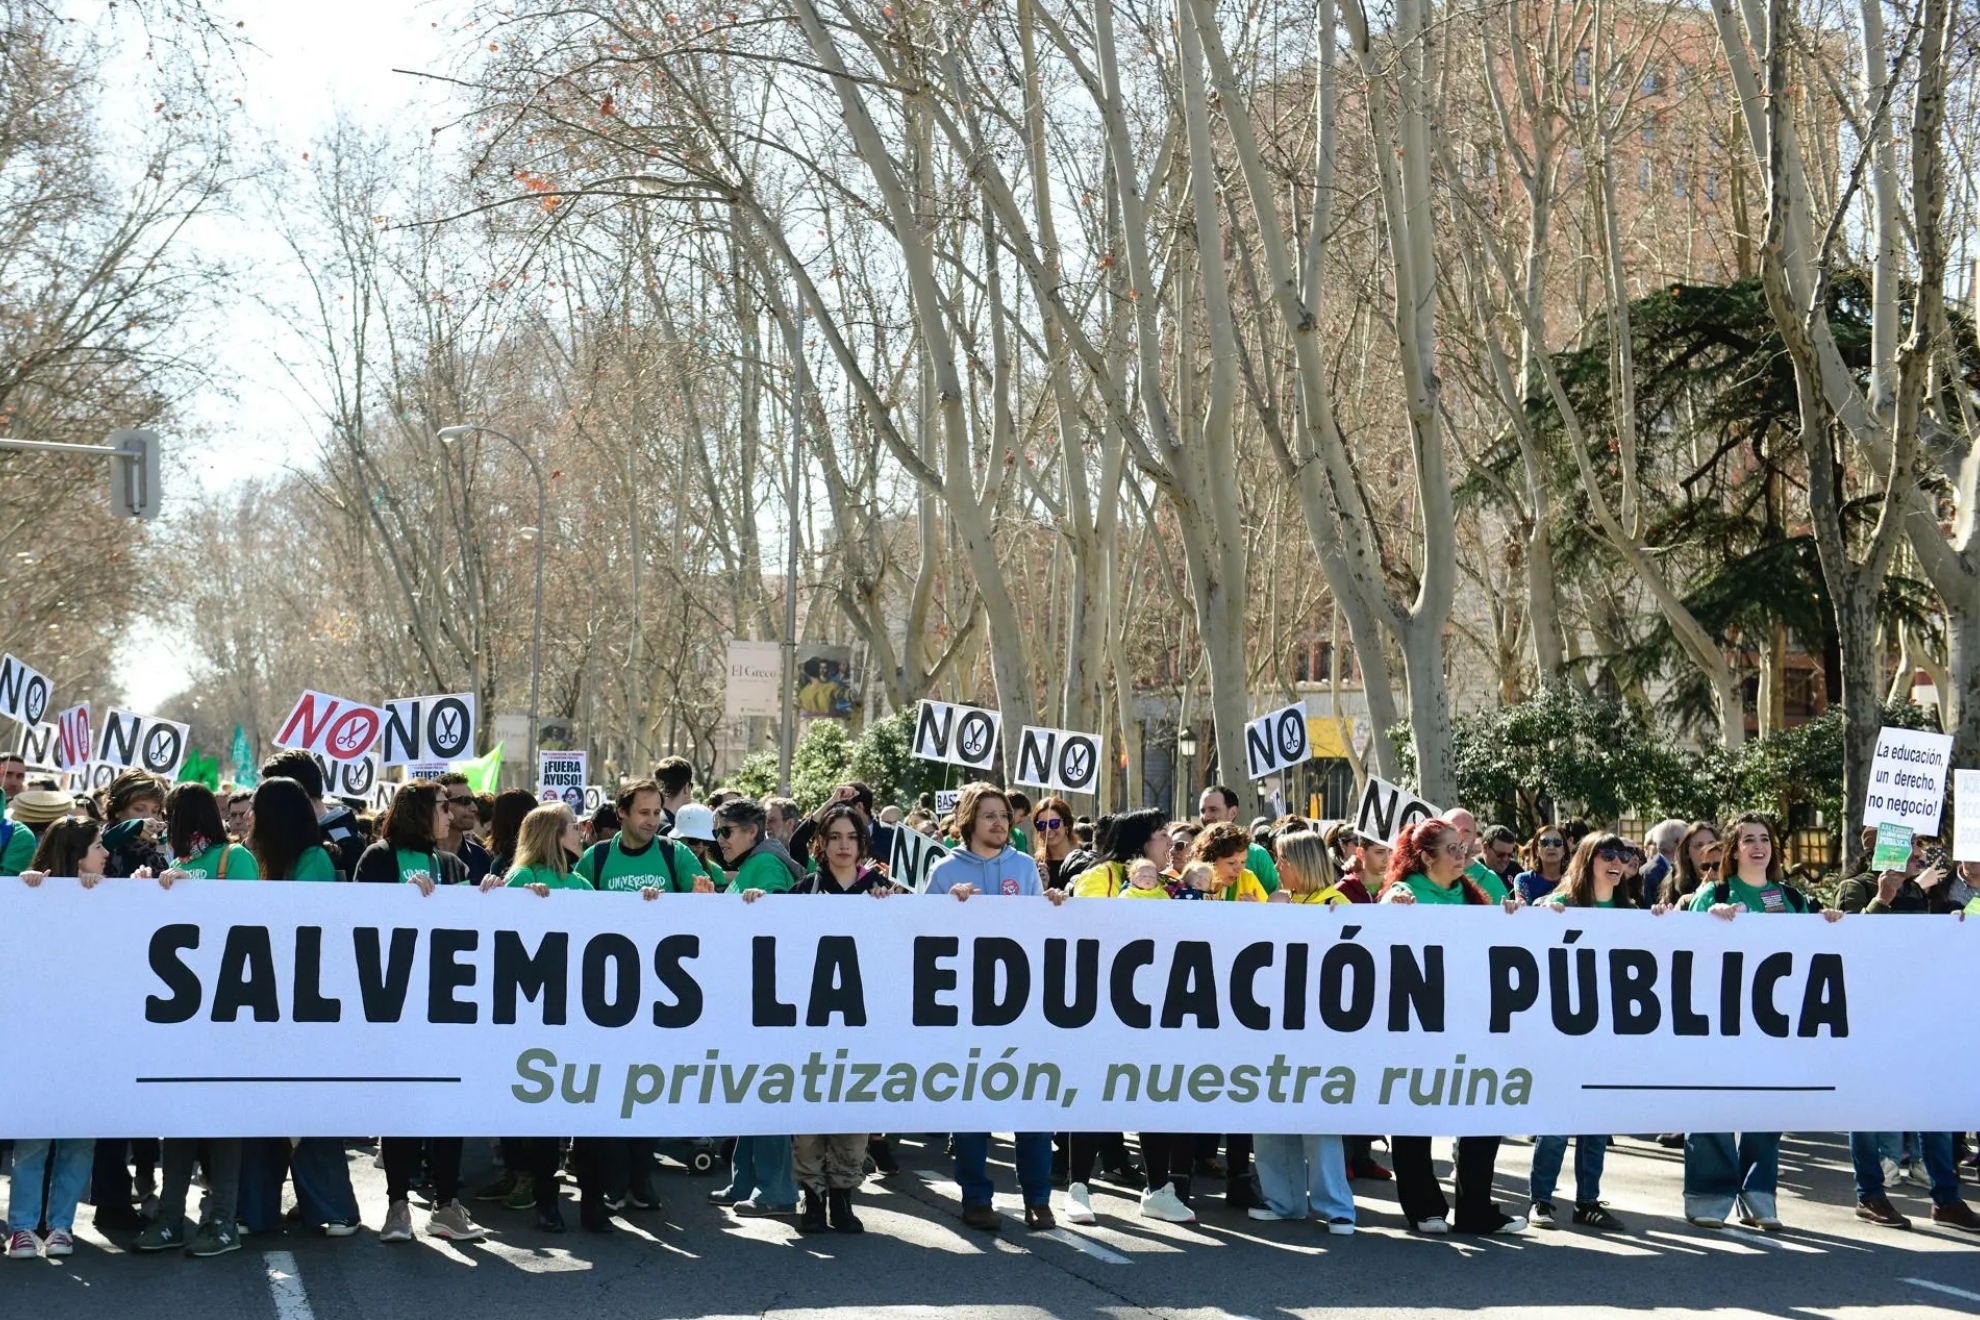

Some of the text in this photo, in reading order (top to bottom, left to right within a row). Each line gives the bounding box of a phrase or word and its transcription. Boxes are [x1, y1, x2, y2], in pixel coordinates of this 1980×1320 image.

[0, 657, 47, 726] NO
[744, 665, 776, 679] Greco
[60, 707, 90, 767] NO
[100, 712, 181, 774] NO
[278, 694, 380, 759] NO
[384, 698, 470, 762] NO
[915, 703, 995, 763] NO
[1247, 708, 1306, 775] NO
[1877, 741, 1943, 768] La educación,
[543, 773, 583, 786] AYUSO!
[544, 761, 582, 773] ¡FUERA
[1018, 730, 1097, 789] NO
[1876, 769, 1937, 792] un derecho,
[1868, 794, 1938, 817] no negocio!
[608, 875, 666, 890] UNIVERSIDAD
[145, 923, 1850, 1038] SALVEMOS LA EDUCACIÓN PÚBLICA
[511, 1046, 1533, 1120] Su privatización, nuestra ruina
